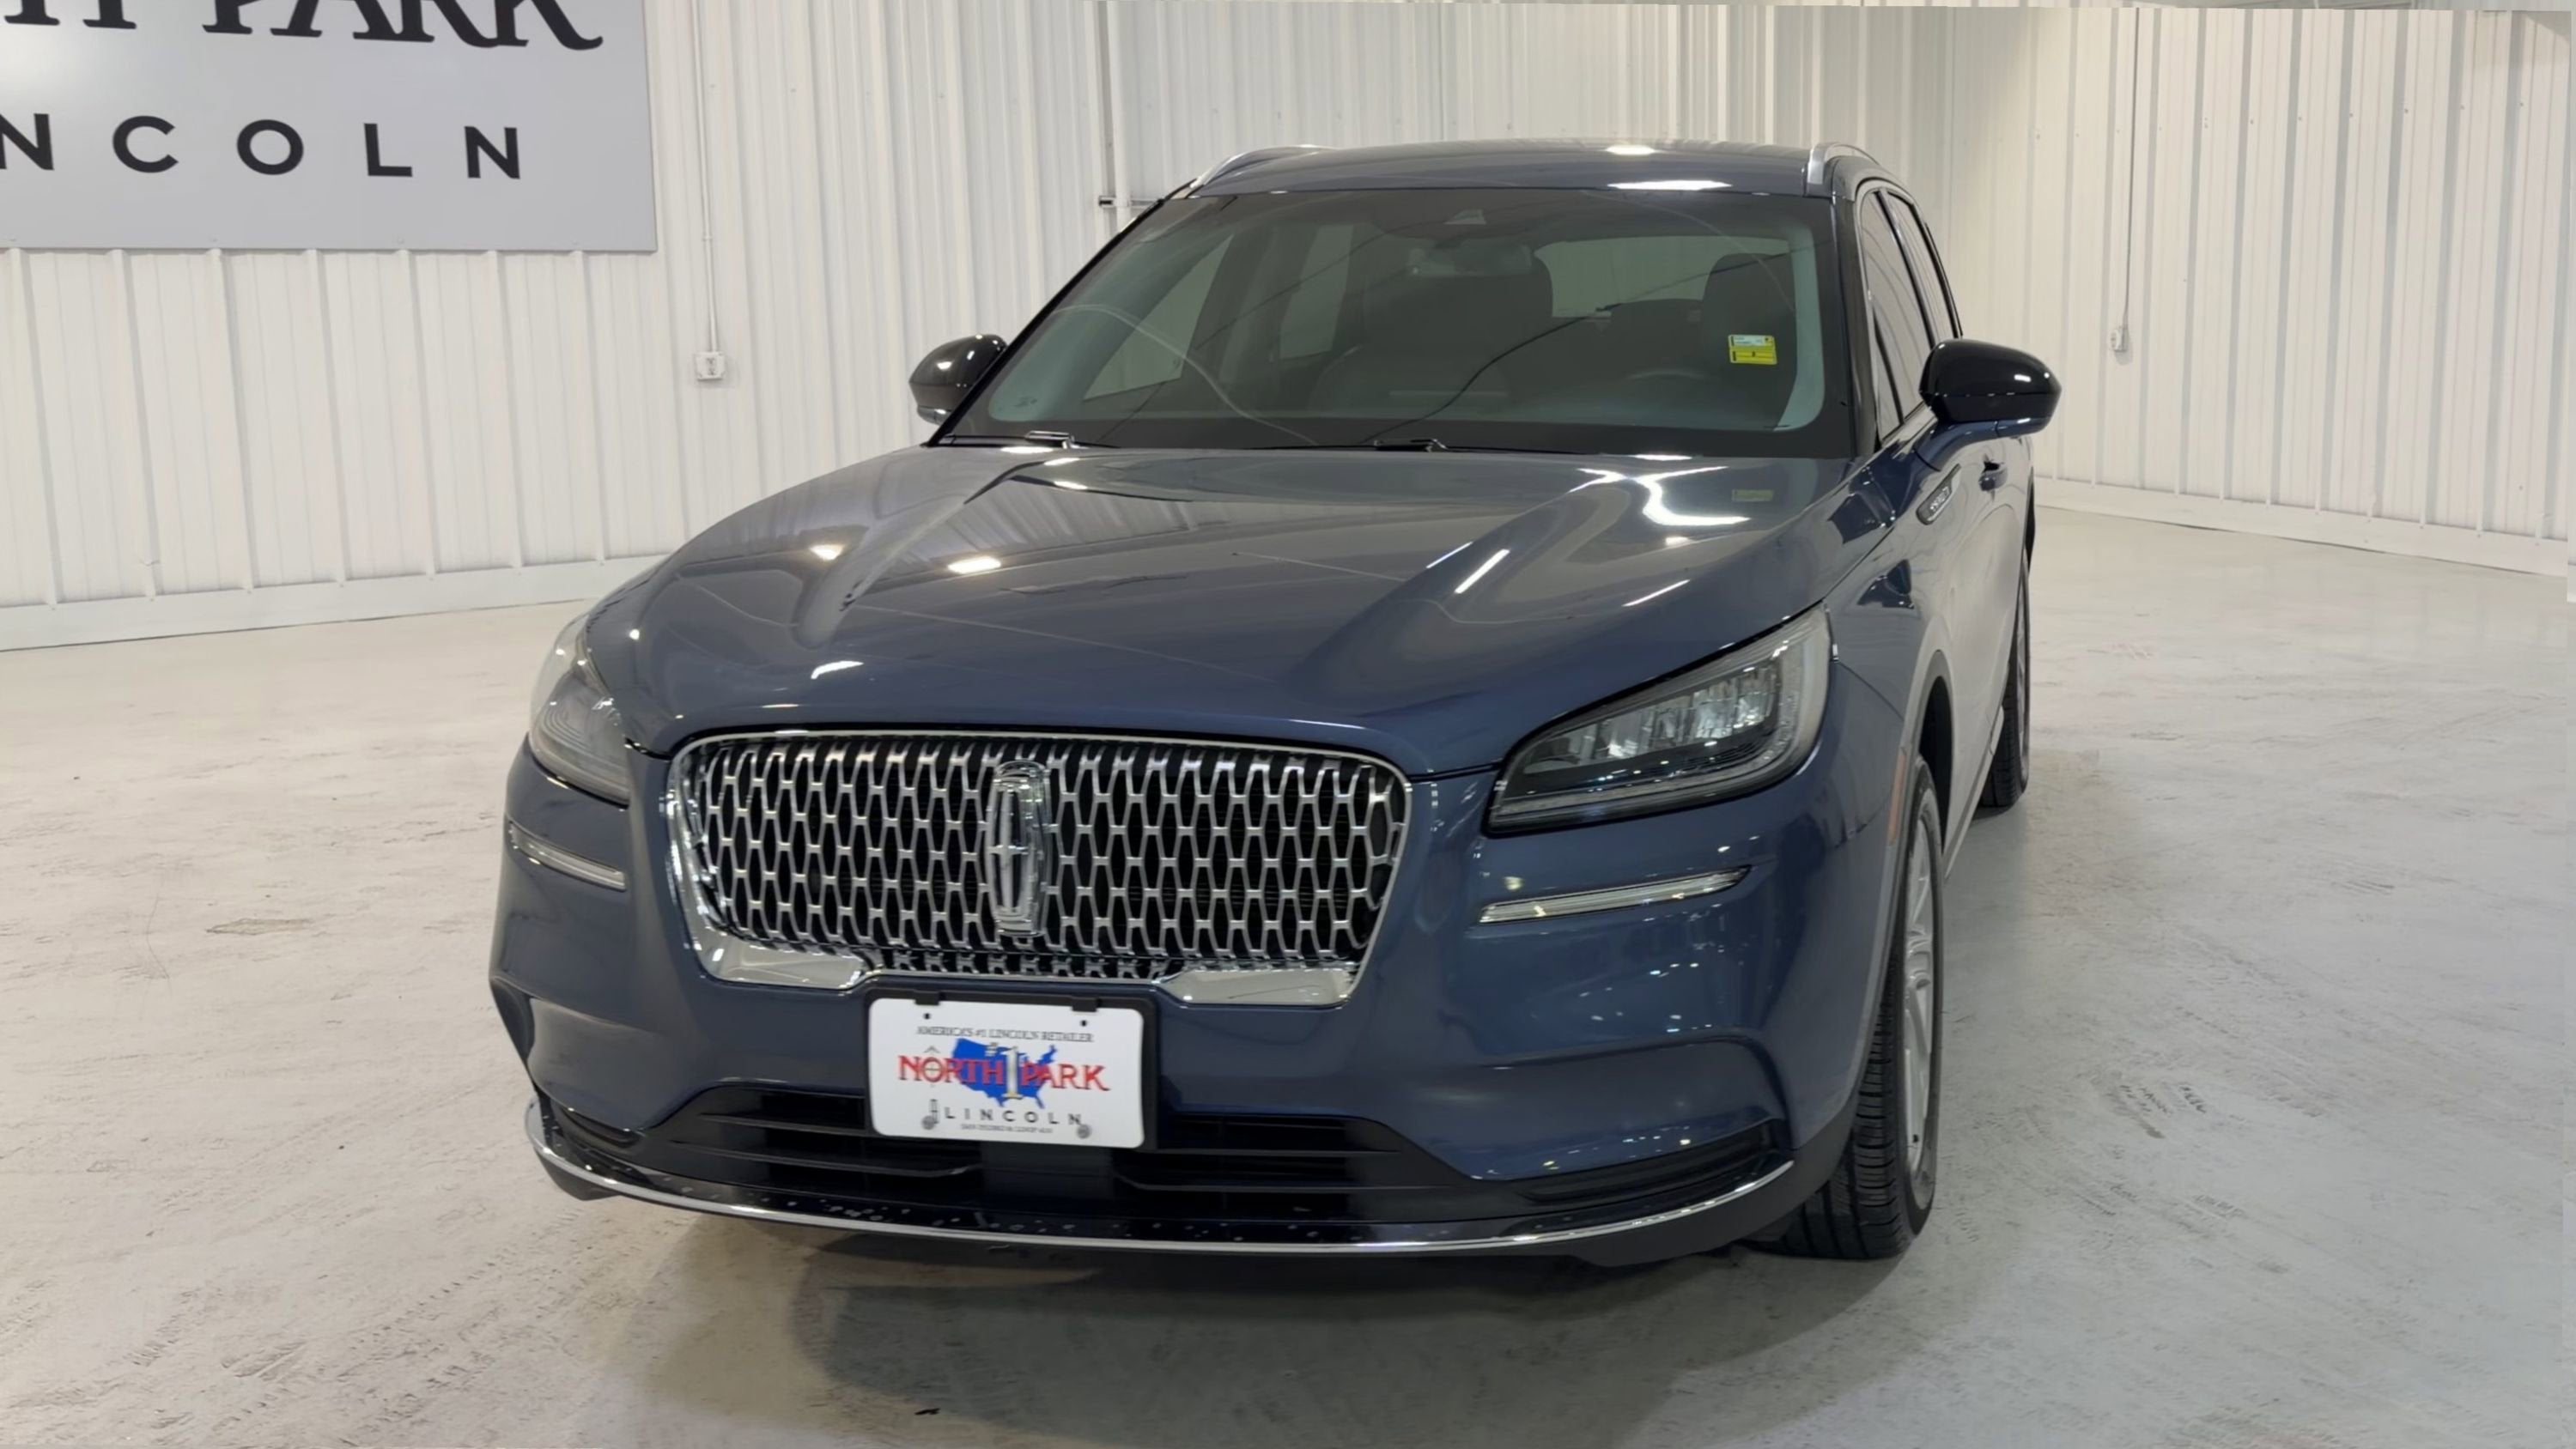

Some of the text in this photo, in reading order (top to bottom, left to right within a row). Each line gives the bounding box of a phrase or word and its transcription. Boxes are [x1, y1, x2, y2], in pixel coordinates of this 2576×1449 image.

[898, 1055, 1110, 1091] NORTH PARK
[945, 1106, 1081, 1125] LINCOLN
